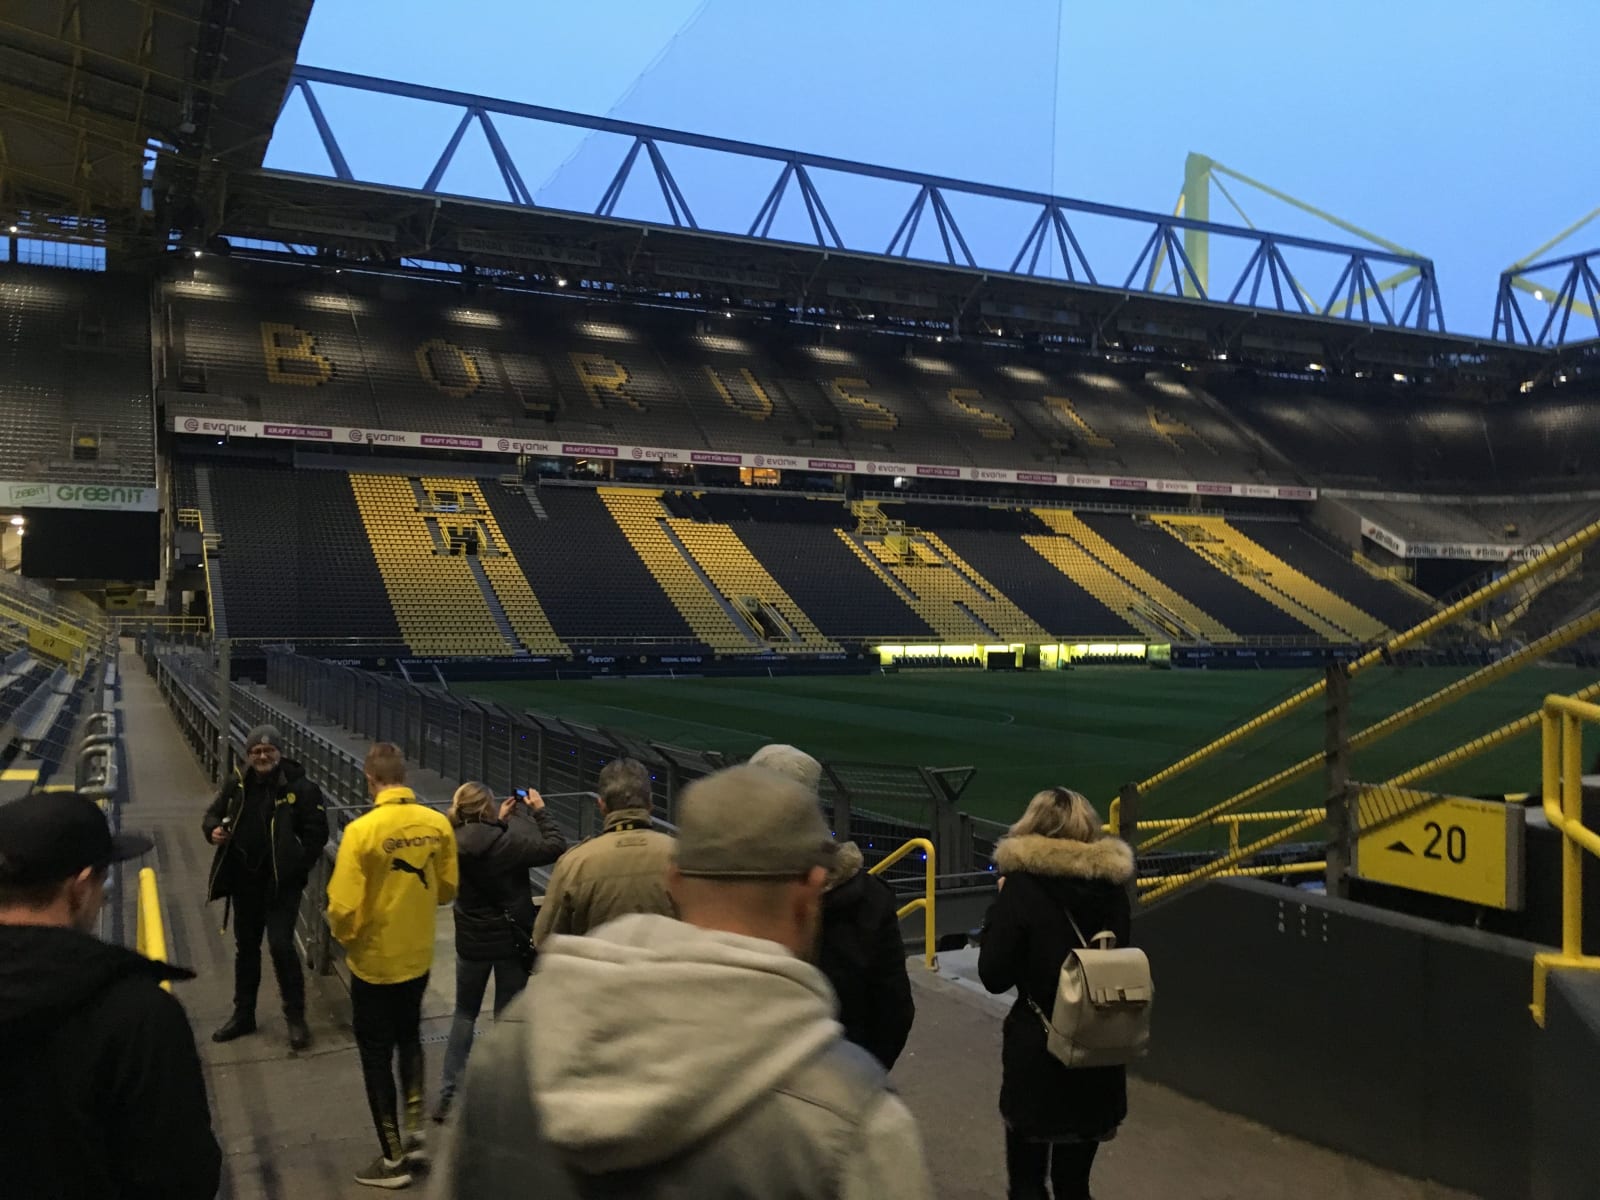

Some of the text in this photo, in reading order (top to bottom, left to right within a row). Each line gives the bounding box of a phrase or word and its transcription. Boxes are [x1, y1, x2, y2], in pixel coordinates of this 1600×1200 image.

[202, 422, 248, 433] EVONIK
[365, 432, 406, 442] EVONIK
[512, 441, 549, 451] EVONIK
[57, 485, 145, 503] GreenIT
[1423, 821, 1467, 863] 20
